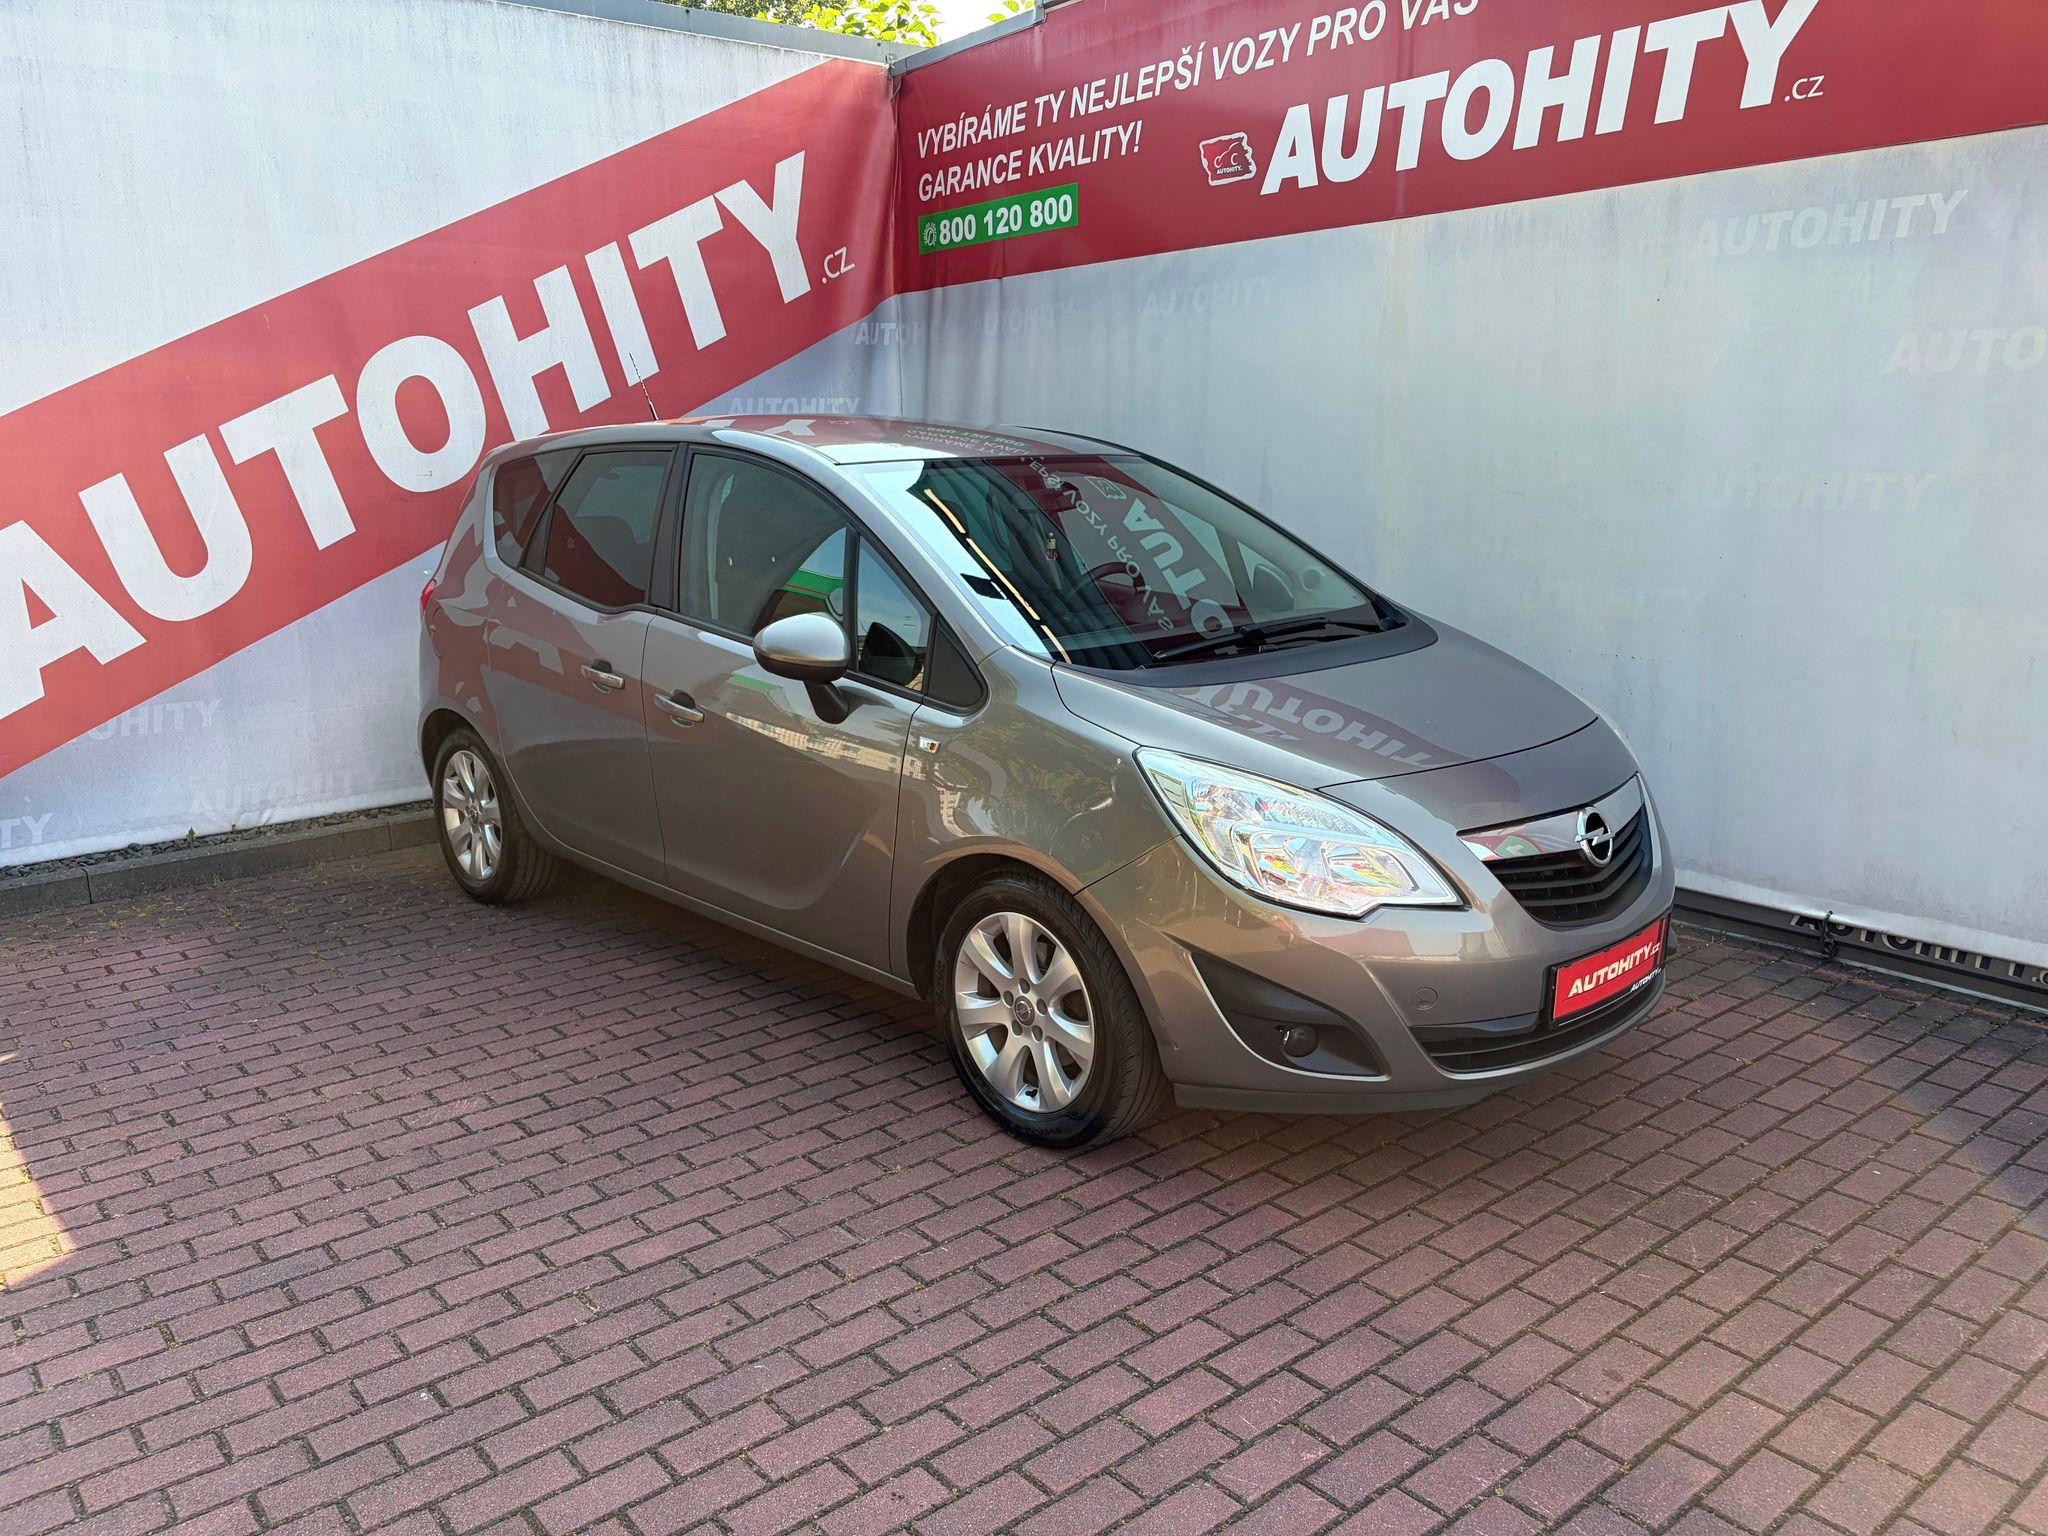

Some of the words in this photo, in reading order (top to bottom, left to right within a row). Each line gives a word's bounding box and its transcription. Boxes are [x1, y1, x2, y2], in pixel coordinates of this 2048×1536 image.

[917, 101, 1027, 159] VYBÍRÁME
[1034, 90, 1066, 128] TY
[1069, 41, 1207, 119] NEJLEPŠÍ
[1212, 22, 1302, 80] VOZY
[1306, 0, 1387, 57] PRO
[918, 150, 1023, 202] GARANCE
[1028, 119, 1143, 177] KVALITY!
[939, 213, 977, 245] 800
[983, 204, 1022, 236] 120
[1029, 194, 1073, 228] 800
[1690, 189, 1968, 260] AUTOHITY
